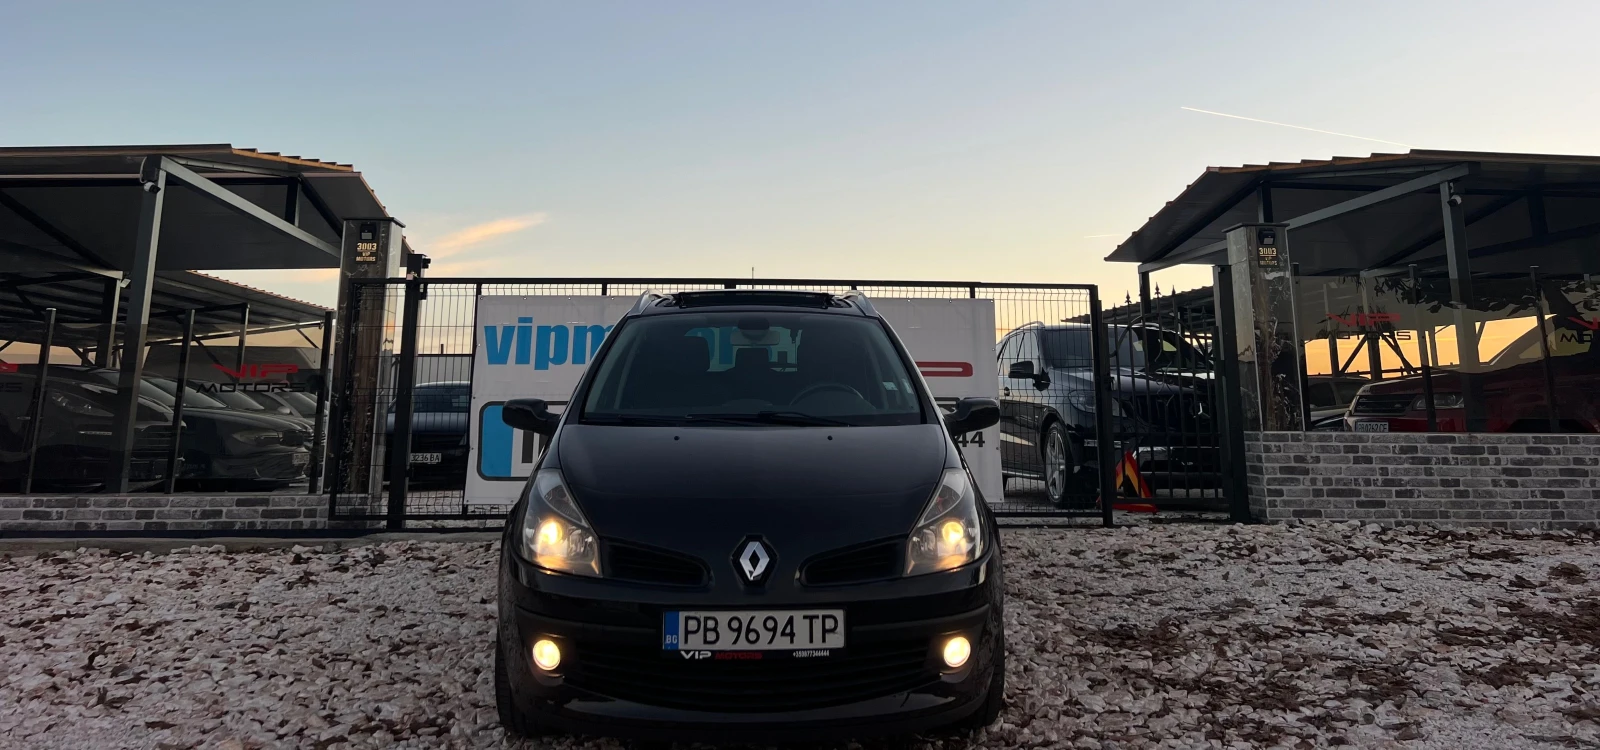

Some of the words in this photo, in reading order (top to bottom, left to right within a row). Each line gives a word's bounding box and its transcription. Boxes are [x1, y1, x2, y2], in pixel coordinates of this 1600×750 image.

[356, 242, 377, 251] 3003
[1258, 247, 1277, 255] 3003
[211, 363, 299, 379] VIP
[196, 383, 306, 393] MOTORS
[665, 634, 678, 644] BG
[683, 615, 720, 645] PB
[727, 615, 796, 645] 9694
[802, 614, 839, 645] TP
[680, 650, 713, 660] VIP
[714, 651, 764, 661] MOTORS
